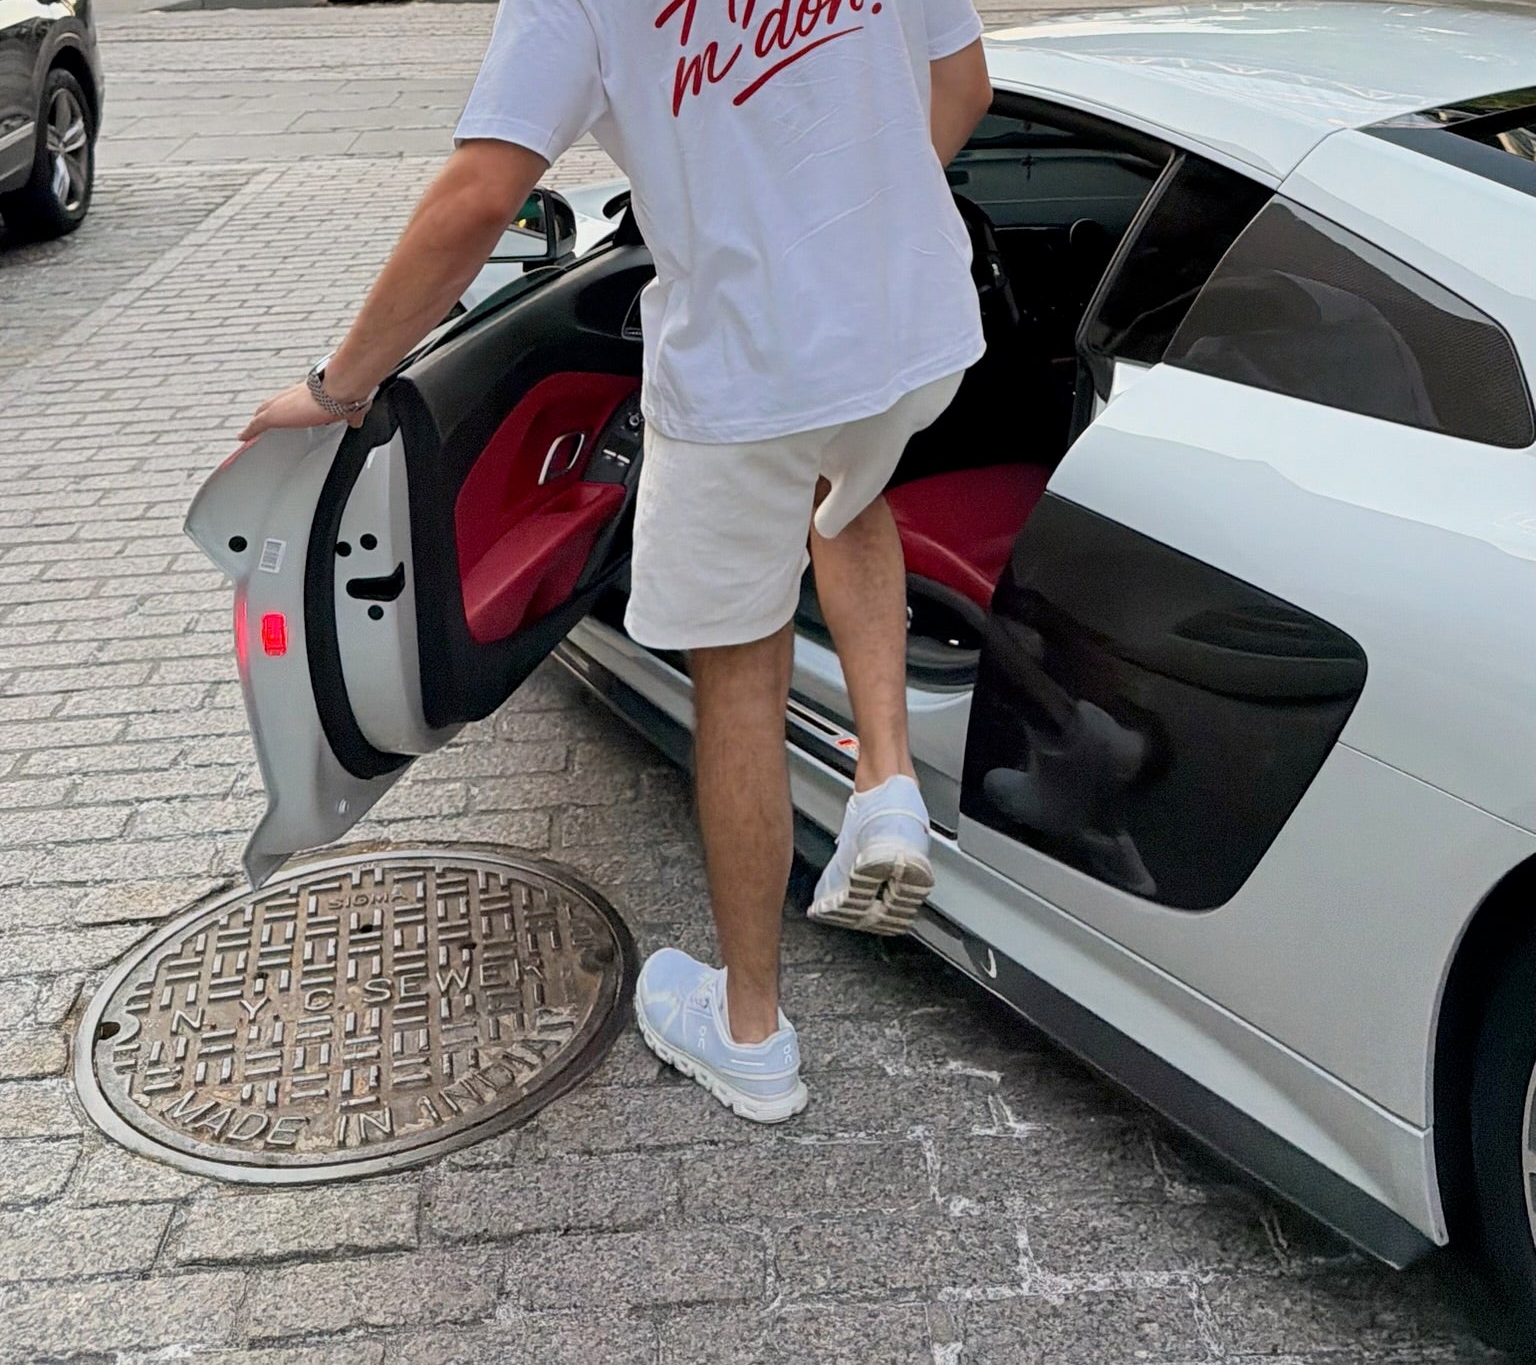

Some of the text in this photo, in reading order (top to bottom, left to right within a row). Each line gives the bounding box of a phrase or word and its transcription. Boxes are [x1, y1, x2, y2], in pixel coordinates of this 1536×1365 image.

[327, 884, 408, 910] SIGMA
[159, 1090, 309, 1146] MADE
[338, 1106, 394, 1147] IN
